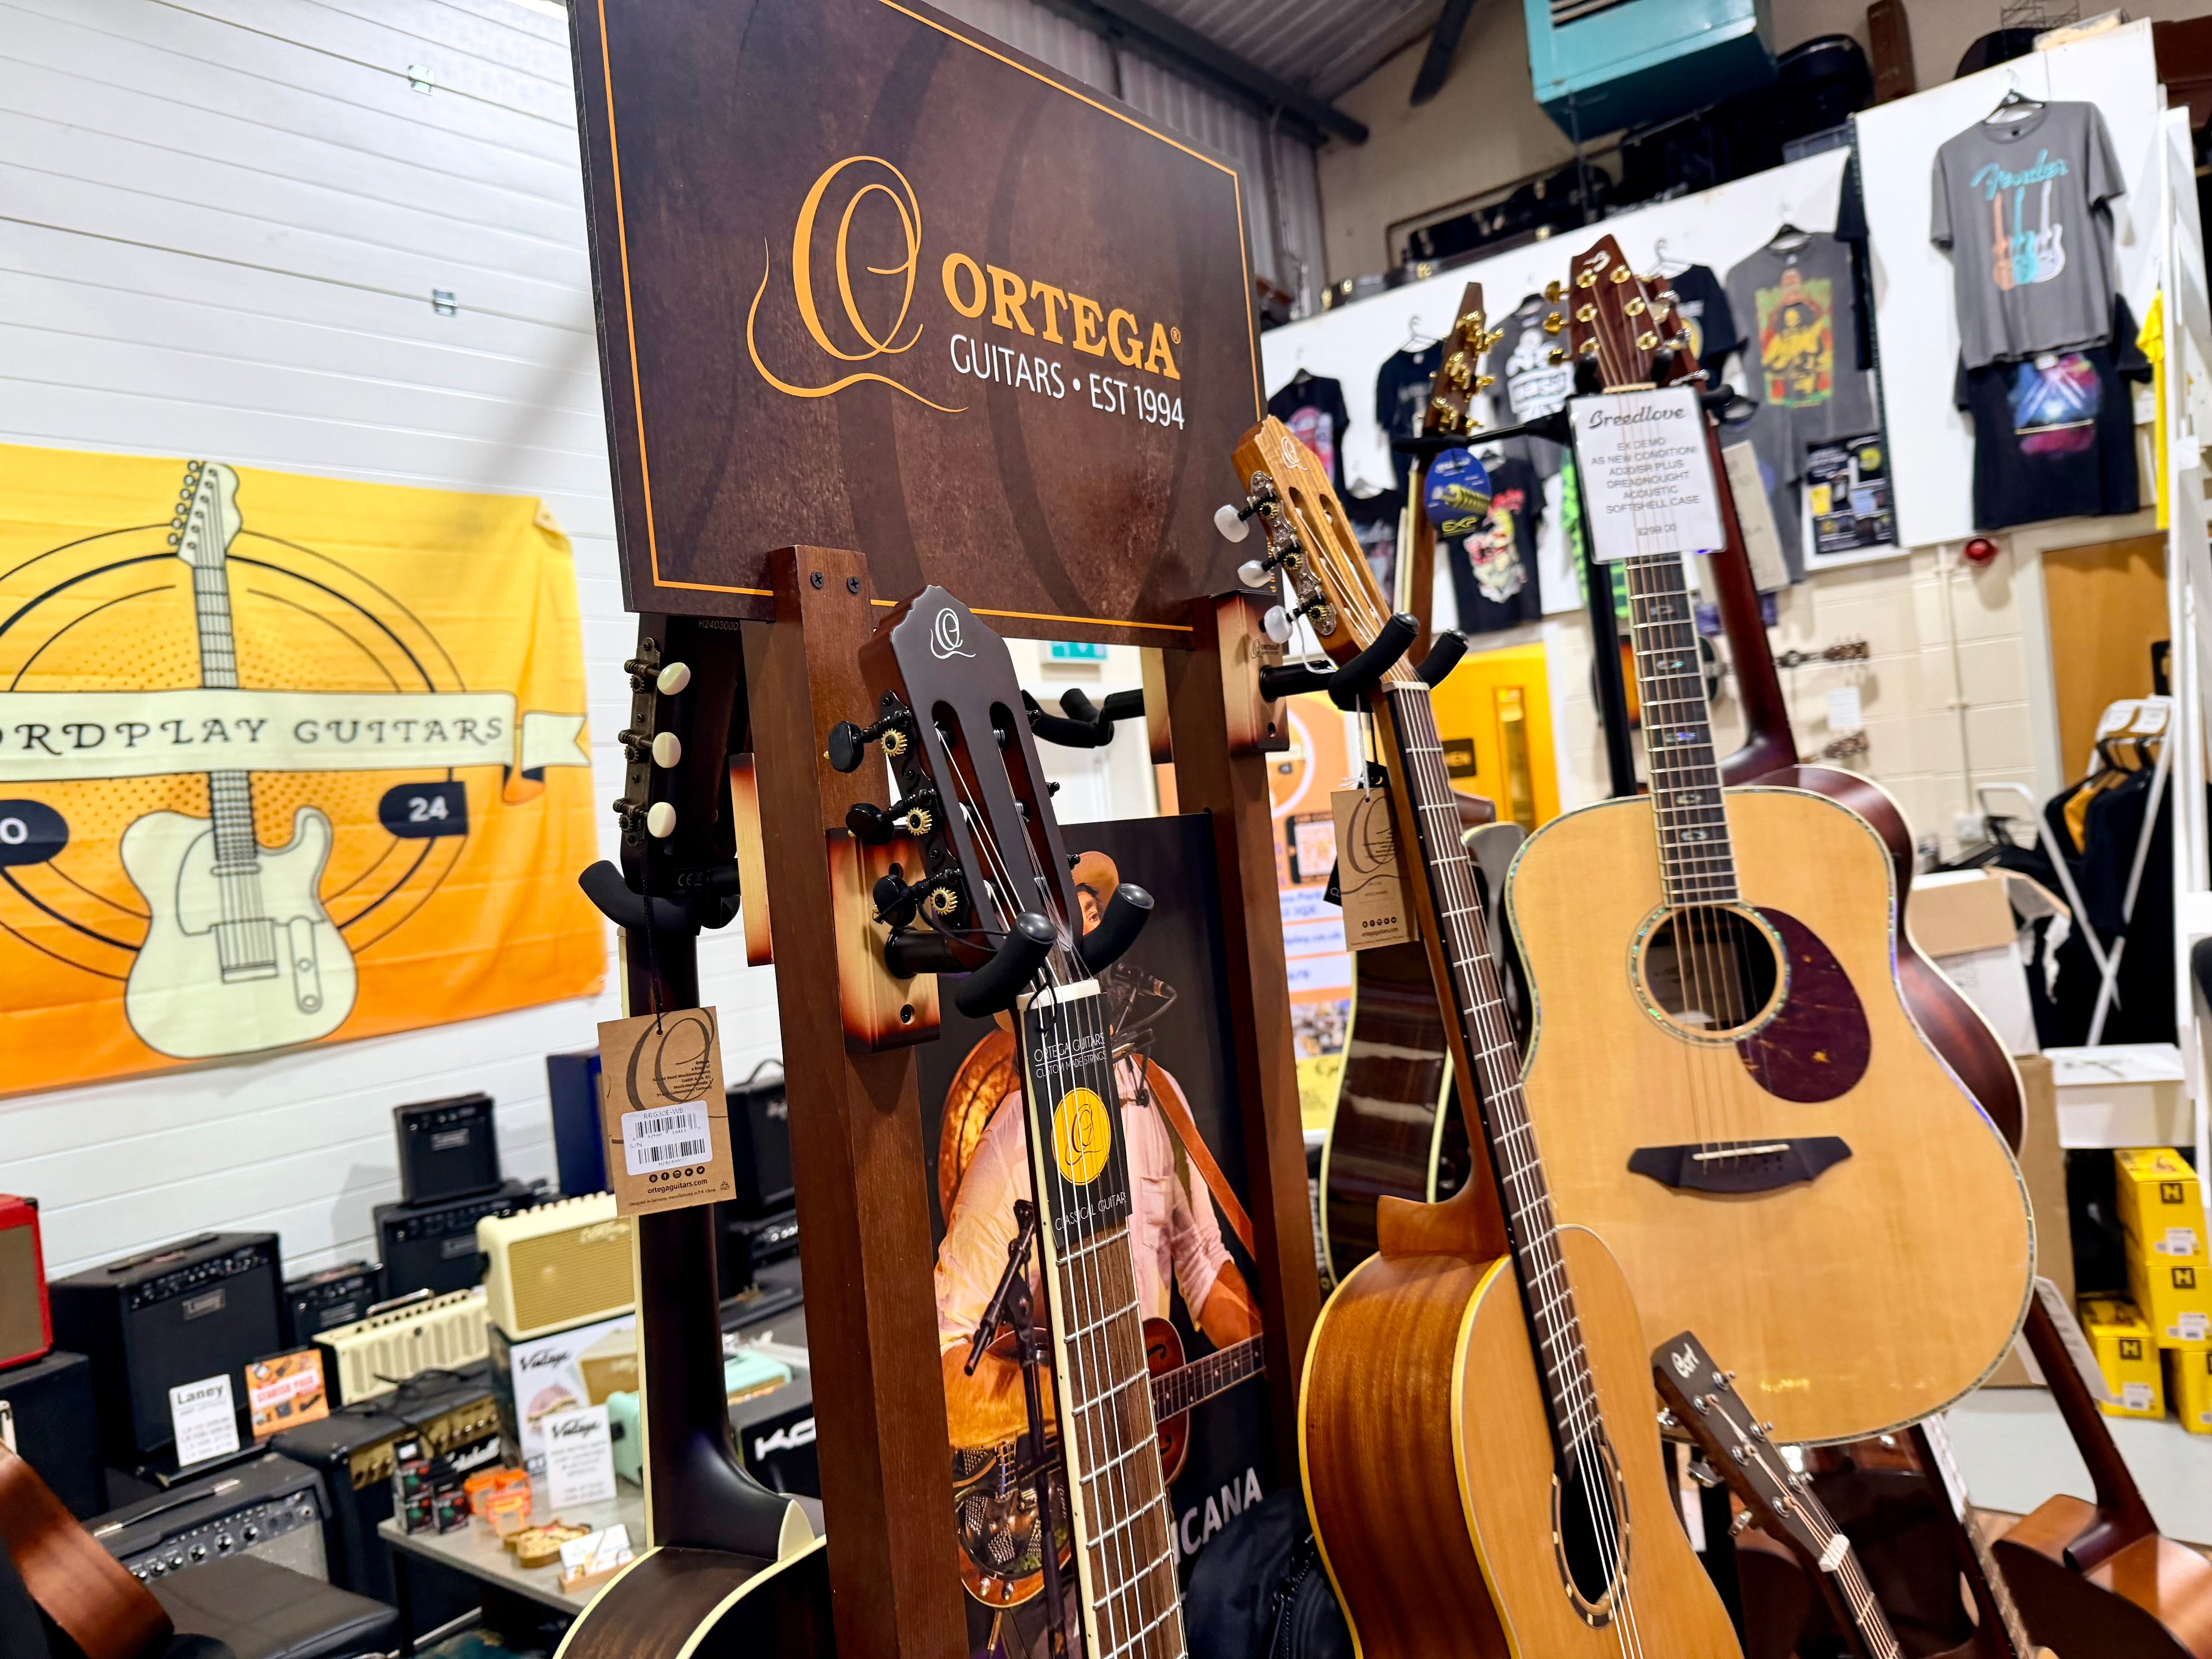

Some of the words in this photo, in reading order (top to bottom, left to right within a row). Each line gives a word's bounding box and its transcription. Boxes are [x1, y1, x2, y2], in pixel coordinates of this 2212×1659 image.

[1970, 148, 2068, 200] Fender
[950, 334, 1065, 399] GUITARS
[1090, 373, 1128, 415] EST
[1133, 385, 1184, 430] 1994
[1589, 406, 1685, 429] Breedlove
[1618, 441, 1631, 450] EX
[1635, 438, 1665, 448] DEMO
[1591, 457, 1605, 465] AS
[1608, 453, 1631, 464] NEW
[1656, 460, 1683, 472] PLUS
[1607, 472, 1690, 489] DREADNOUGHT
[1624, 485, 1678, 499] ACOUSTIC
[1670, 496, 1700, 506] CASE
[0, 718, 267, 755] RDPLAY
[293, 717, 502, 745] GUITARS
[408, 796, 448, 822] 24
[1034, 1042, 1069, 1061] ORTEGA
[1073, 1032, 1105, 1051] GUITARS
[1036, 1062, 1065, 1078] CUSTOM
[1065, 1056, 1082, 1070] MADE
[1084, 1051, 1107, 1065] STRINGS
[644, 1108, 683, 1119] RRG30E-WB
[648, 1179, 708, 1194] ortegaguitars.com
[1055, 1204, 1096, 1230] CLASSICAL
[1098, 1192, 1127, 1212] GUITAR
[178, 1385, 223, 1405] Laney
[1170, 1467, 1263, 1565] ICANA
